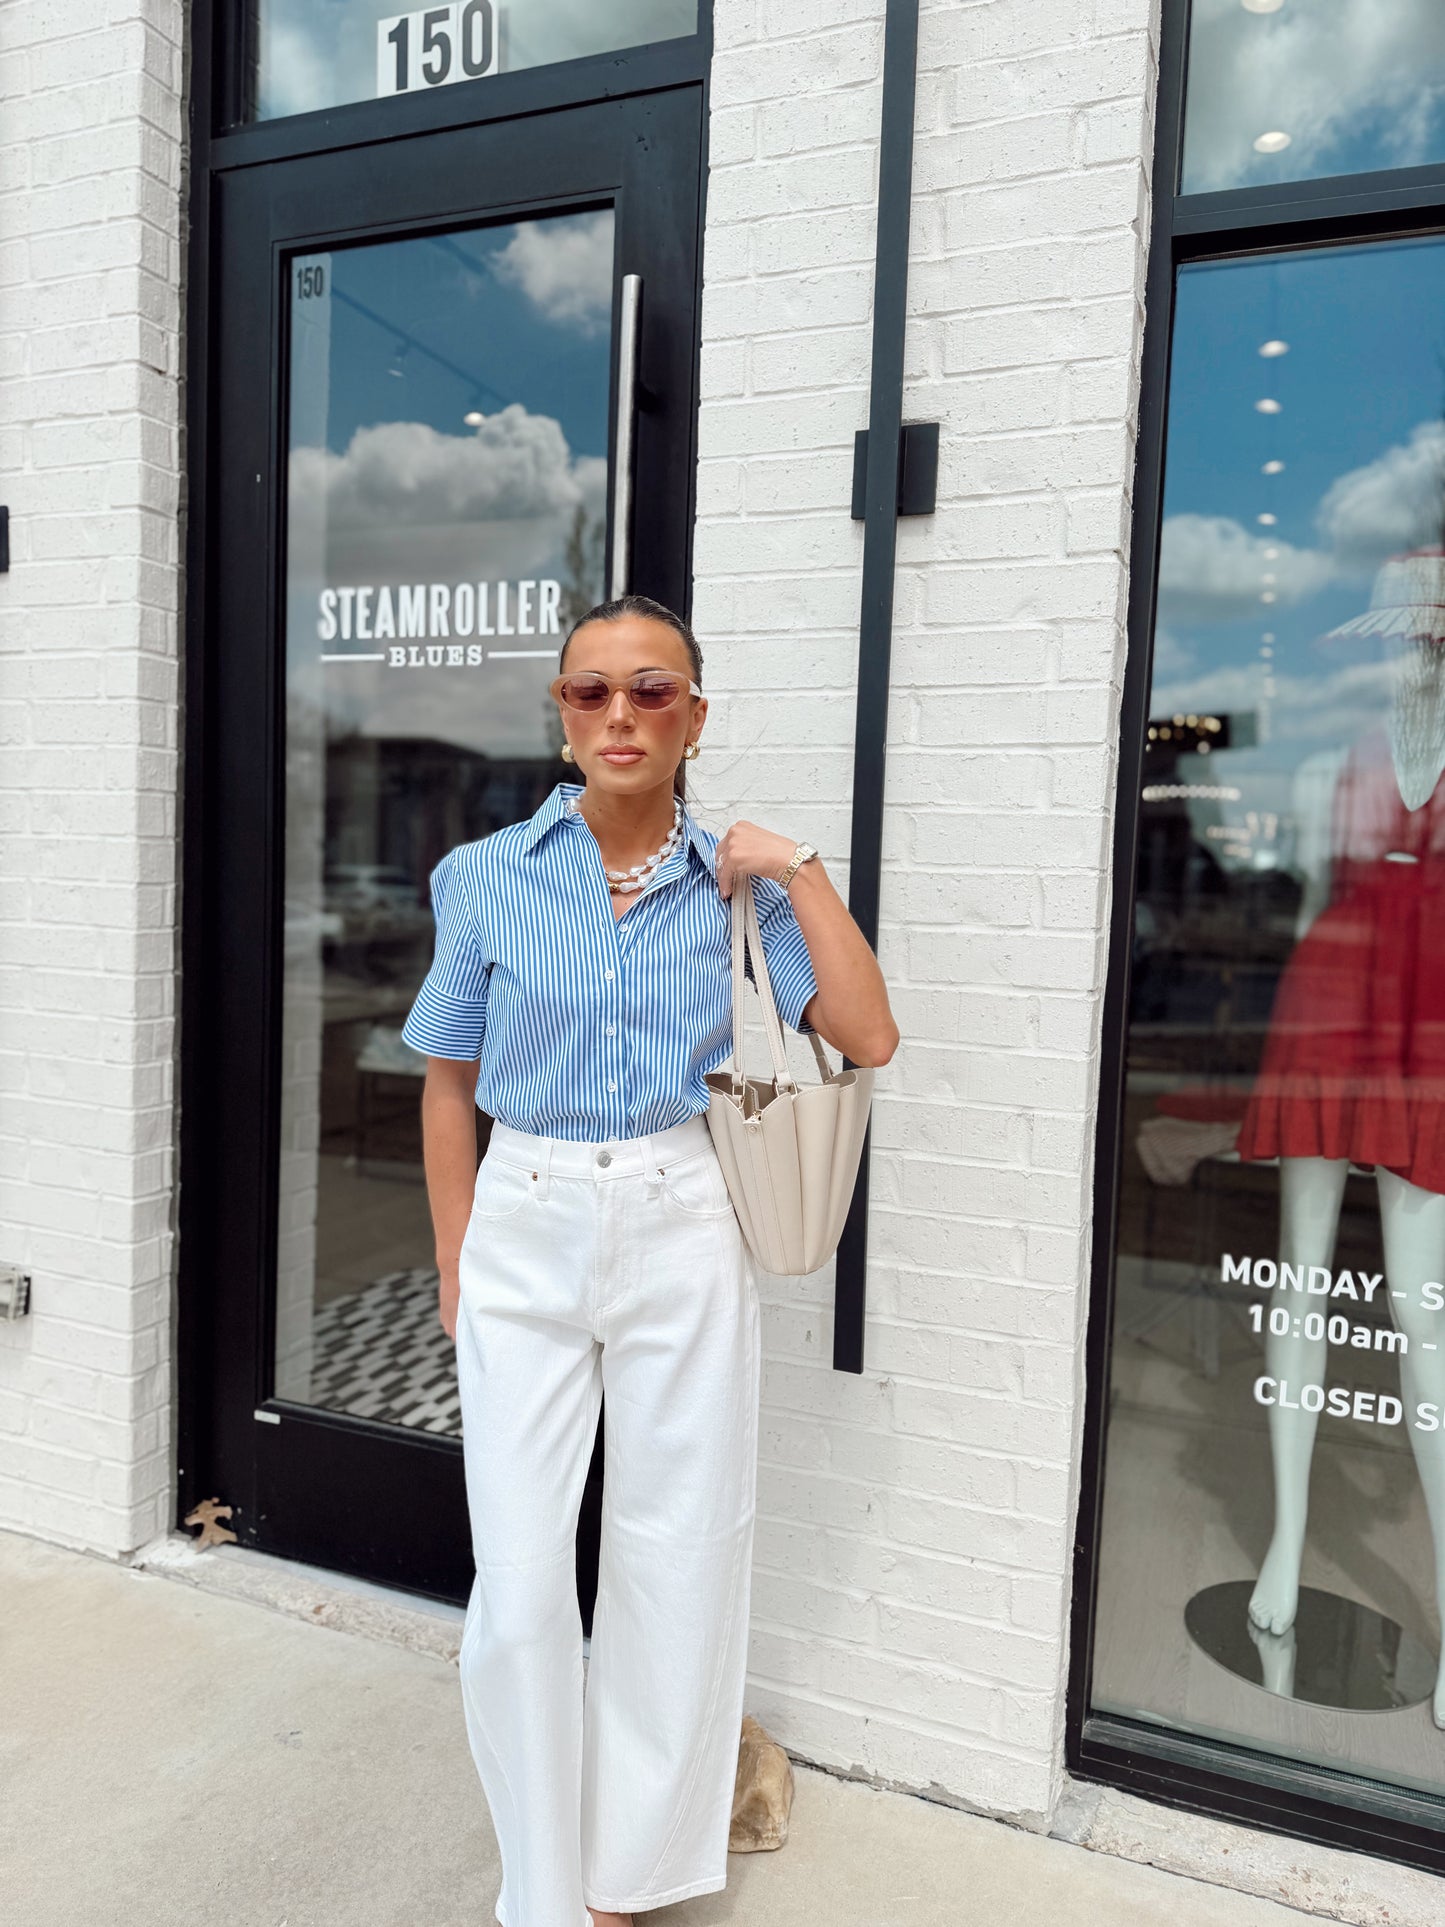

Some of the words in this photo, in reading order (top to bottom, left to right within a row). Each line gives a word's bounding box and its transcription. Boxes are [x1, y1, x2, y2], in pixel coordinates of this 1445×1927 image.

[388, 0, 492, 91] 150
[297, 266, 324, 300] 150
[318, 579, 561, 640] STEAMROLLER
[388, 645, 483, 667] BLUES
[1221, 1253, 1383, 1302] MONDAY
[1248, 1304, 1409, 1354] 10:00am
[1253, 1376, 1403, 1426] CLOSED
[1414, 1402, 1445, 1432] S
